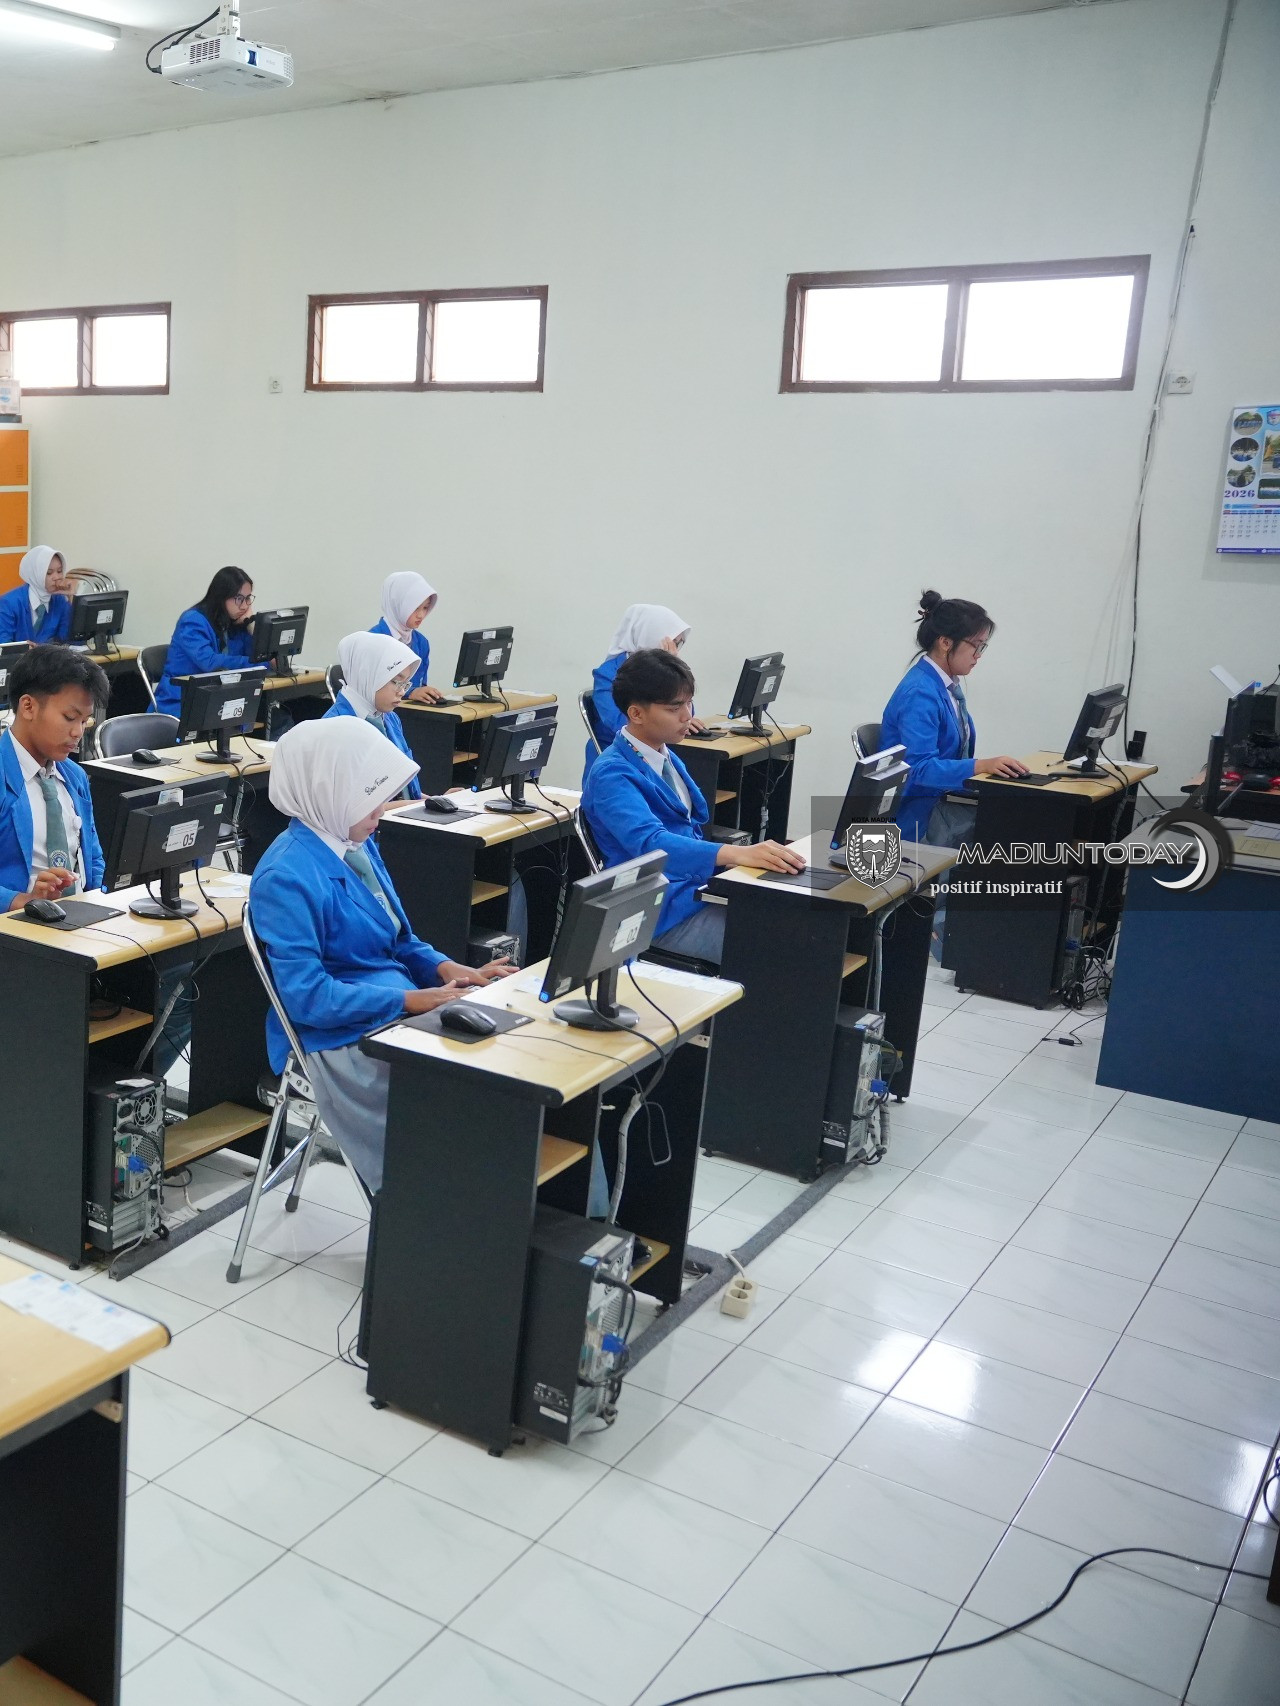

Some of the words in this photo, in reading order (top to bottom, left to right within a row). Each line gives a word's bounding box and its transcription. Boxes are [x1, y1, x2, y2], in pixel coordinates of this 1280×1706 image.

[1224, 490, 1255, 498] 2026
[233, 707, 242, 717] 09
[182, 833, 194, 847] 05
